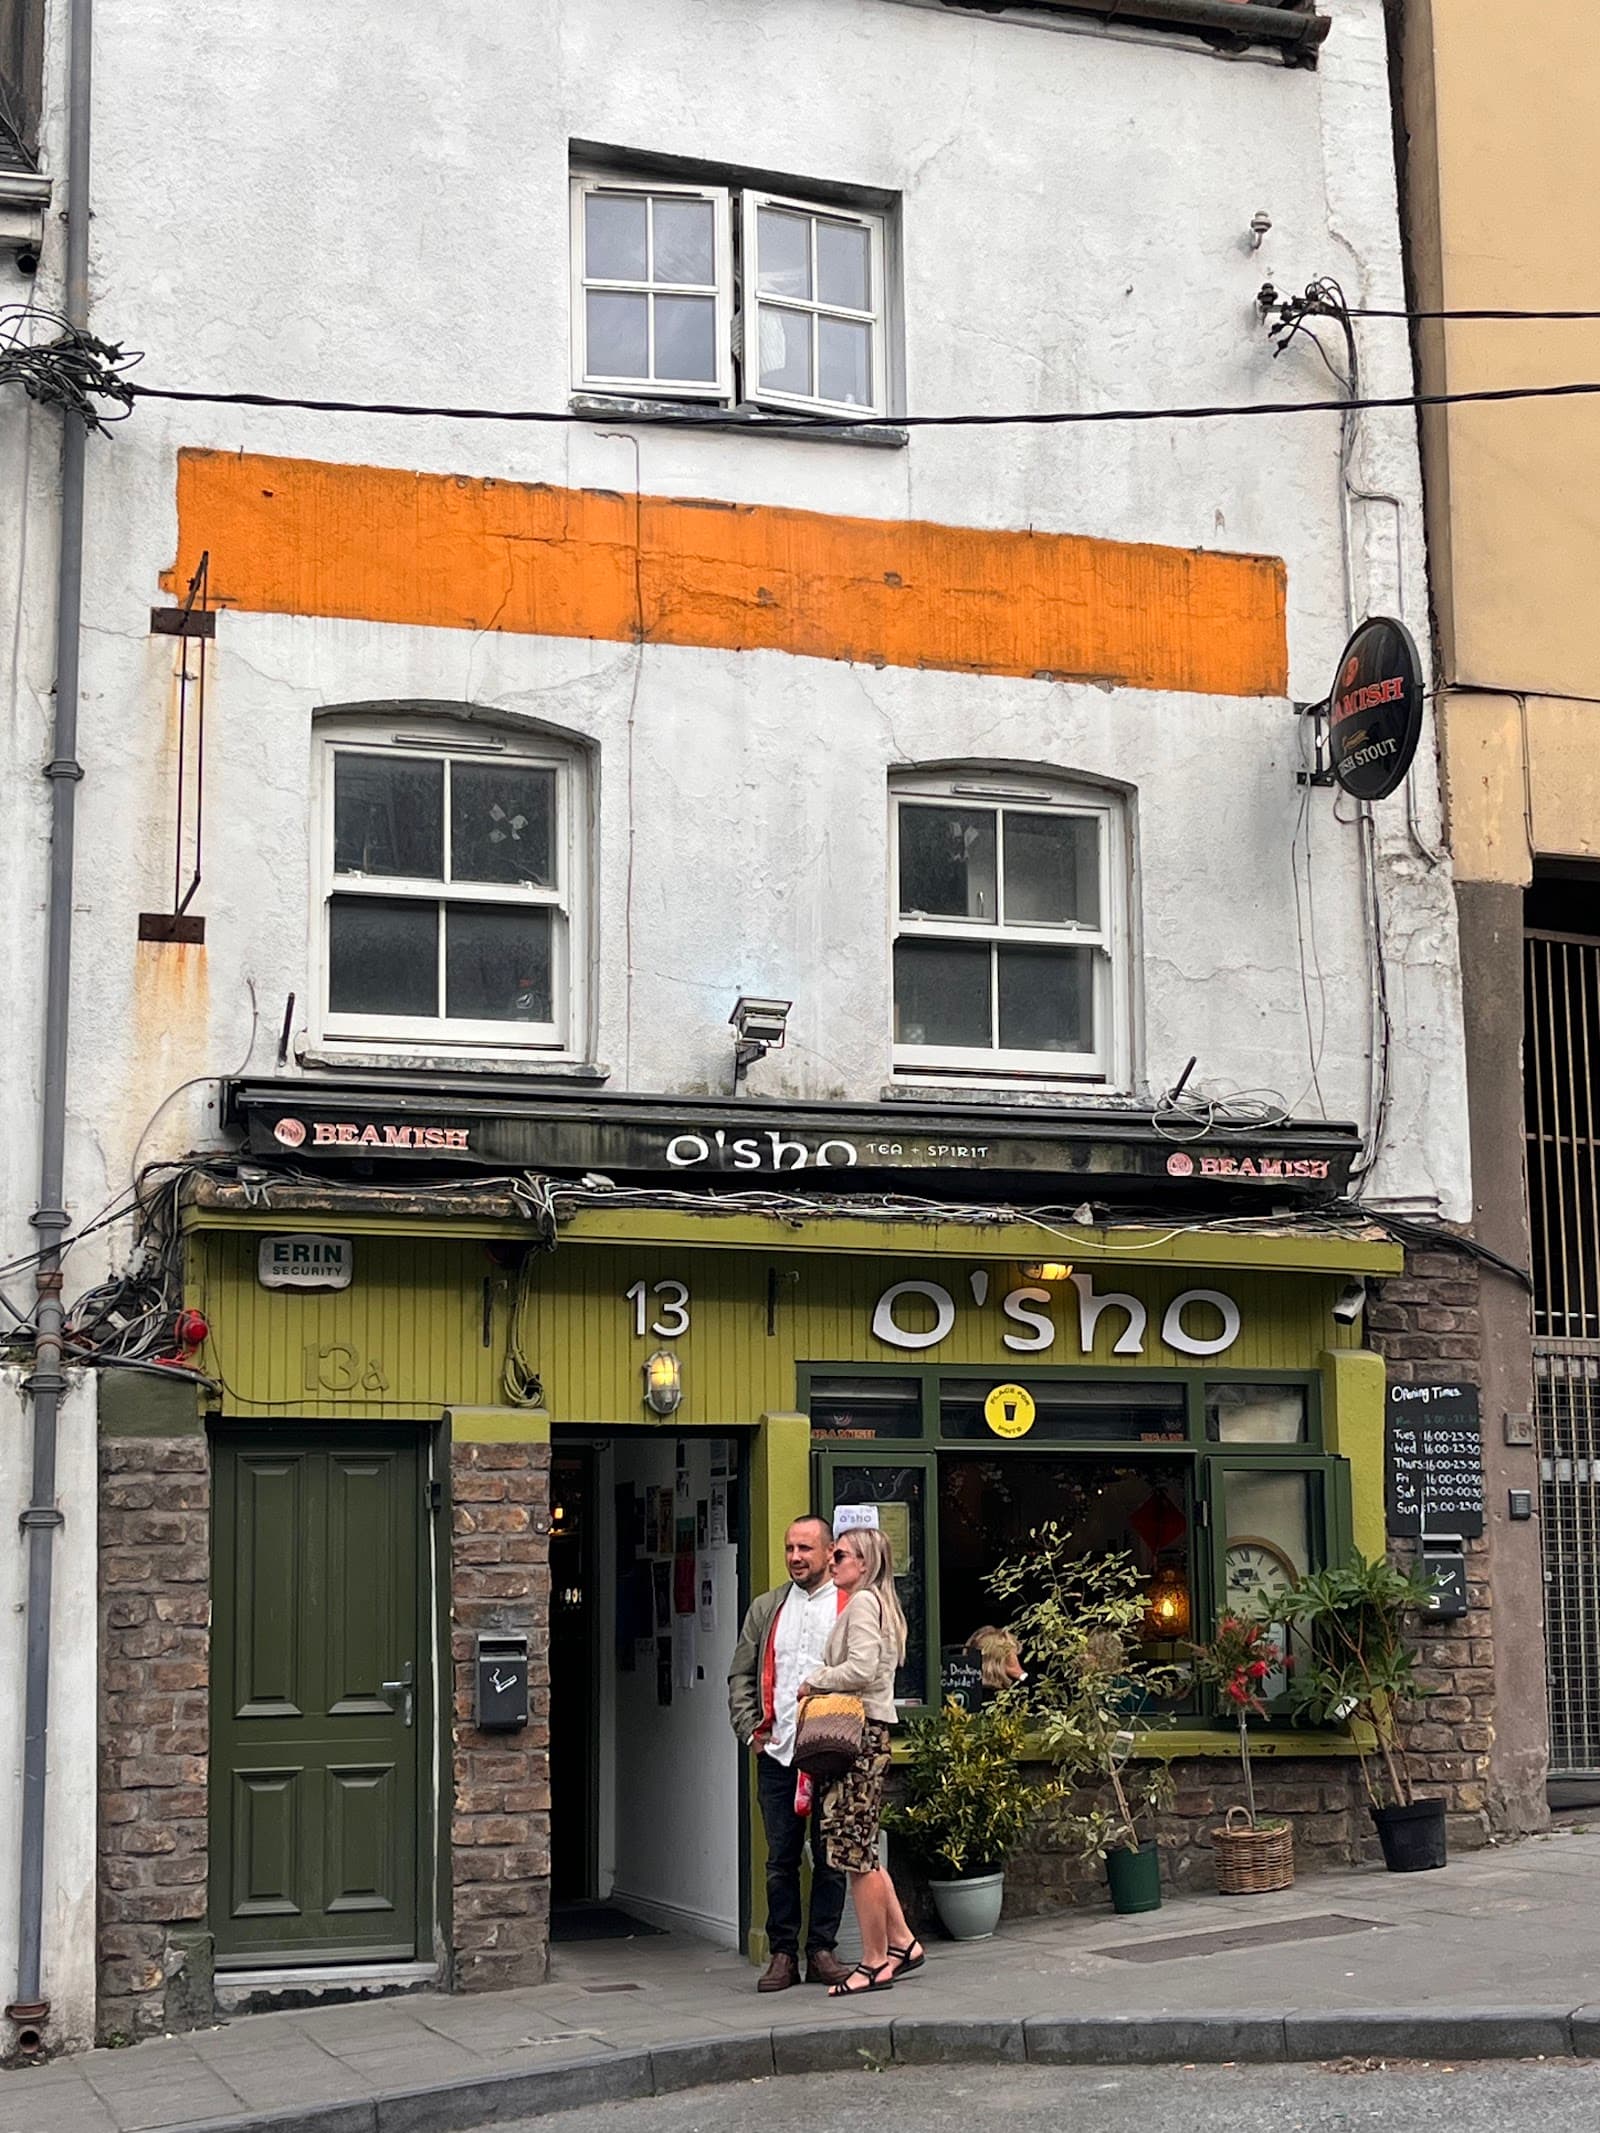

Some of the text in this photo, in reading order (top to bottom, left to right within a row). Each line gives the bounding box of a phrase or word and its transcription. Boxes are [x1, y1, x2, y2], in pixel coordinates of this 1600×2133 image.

[1354, 738, 1397, 766] STOUT
[312, 1122, 470, 1150] BEAMISH
[865, 1143, 903, 1155] TEA
[927, 1145, 989, 1158] SPIRIT
[1199, 1157, 1331, 1179] BEAMISH
[273, 1243, 342, 1263] ERIN
[272, 1265, 342, 1277] SECURITY
[625, 1280, 690, 1337] 13
[303, 1342, 390, 1392] 13a
[1392, 1429, 1416, 1440] Tues
[1394, 1440, 1417, 1454] Wed
[1396, 1473, 1410, 1483] Fri
[1396, 1485, 1416, 1499] Sat
[1397, 1502, 1419, 1514] Sun
